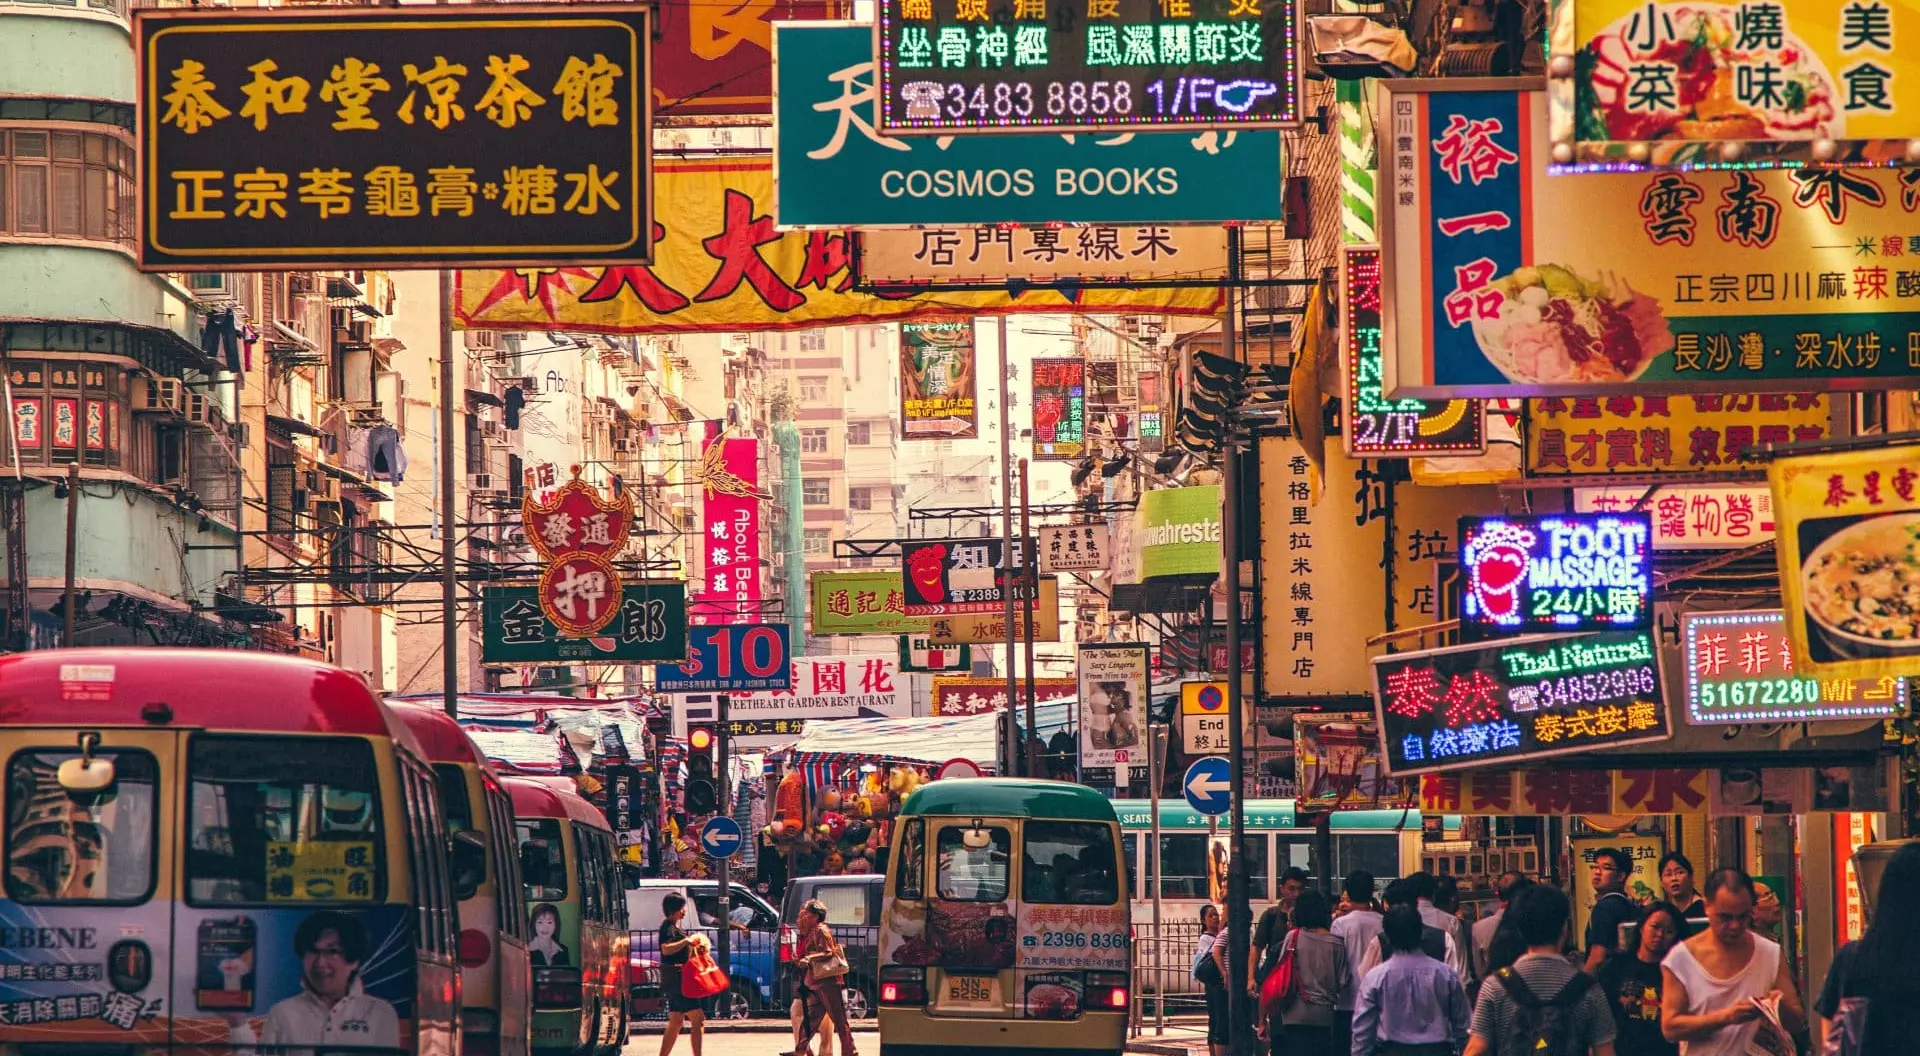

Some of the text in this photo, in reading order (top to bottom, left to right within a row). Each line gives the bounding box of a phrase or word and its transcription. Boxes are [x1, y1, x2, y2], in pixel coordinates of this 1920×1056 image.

[898, 26, 1048, 67] 坐骨神經
[947, 78, 1216, 118] 3483 8858 1/F
[503, 164, 621, 216] 糖水
[881, 168, 1178, 198] COSMOS BOOKS
[1434, 114, 1518, 328] 裕一品
[1674, 332, 1764, 372] 長沙灣
[1795, 331, 1882, 370] 深水埗
[1357, 412, 1418, 444] 2/F
[1551, 525, 1644, 558] FOOT
[732, 509, 751, 624] About Beaut
[1288, 456, 1314, 678] 香格里拉米線專門店
[1529, 555, 1645, 590] MASSAGE
[553, 565, 606, 620] 押
[1532, 586, 1640, 616] 24小時
[502, 599, 666, 644] 金郎
[1108, 661, 1136, 670] Lingerie
[787, 696, 829, 709] GARDEN
[831, 694, 896, 707] RESTAURANT
[1386, 666, 1500, 726] 泰然
[1539, 666, 1655, 708] 34852996
[1701, 679, 1819, 708] 51672280
[1199, 719, 1224, 730] End
[1195, 734, 1230, 749] 終止
[1123, 814, 1153, 824] SEATS
[1043, 932, 1086, 947] 2396
[950, 987, 990, 1000] 5296
[960, 978, 980, 989] NN
